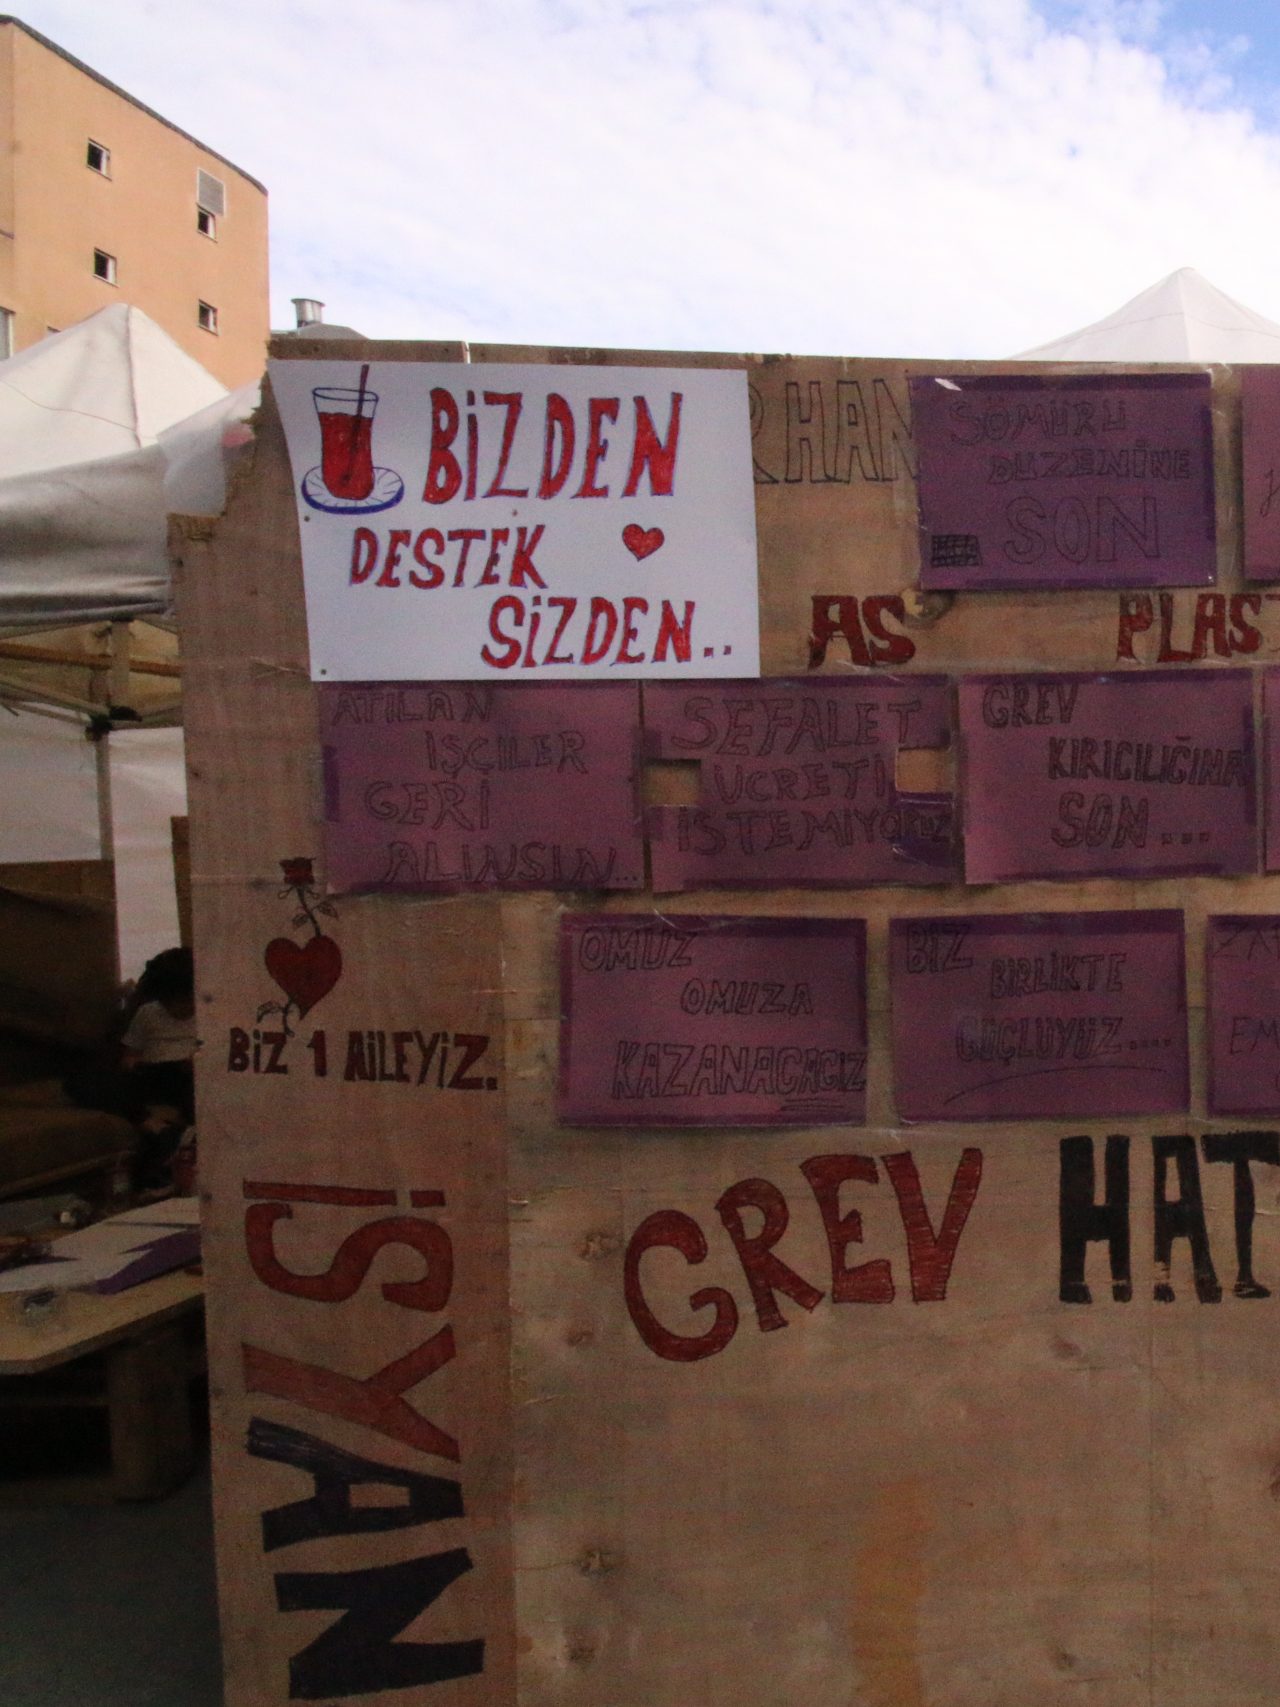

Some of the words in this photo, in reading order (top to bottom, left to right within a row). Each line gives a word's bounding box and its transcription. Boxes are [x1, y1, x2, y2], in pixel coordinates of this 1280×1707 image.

[349, 524, 549, 590] DESTEK
[1003, 495, 1161, 565] SON
[808, 593, 917, 668] AS
[331, 689, 495, 726] ATILAN
[671, 696, 921, 757] SEFALET
[983, 682, 1078, 728] GREV
[578, 927, 699, 971] OMUZ
[680, 977, 815, 1015] OMUZA
[307, 1030, 328, 1077] 1
[624, 1147, 982, 1362] GREV
